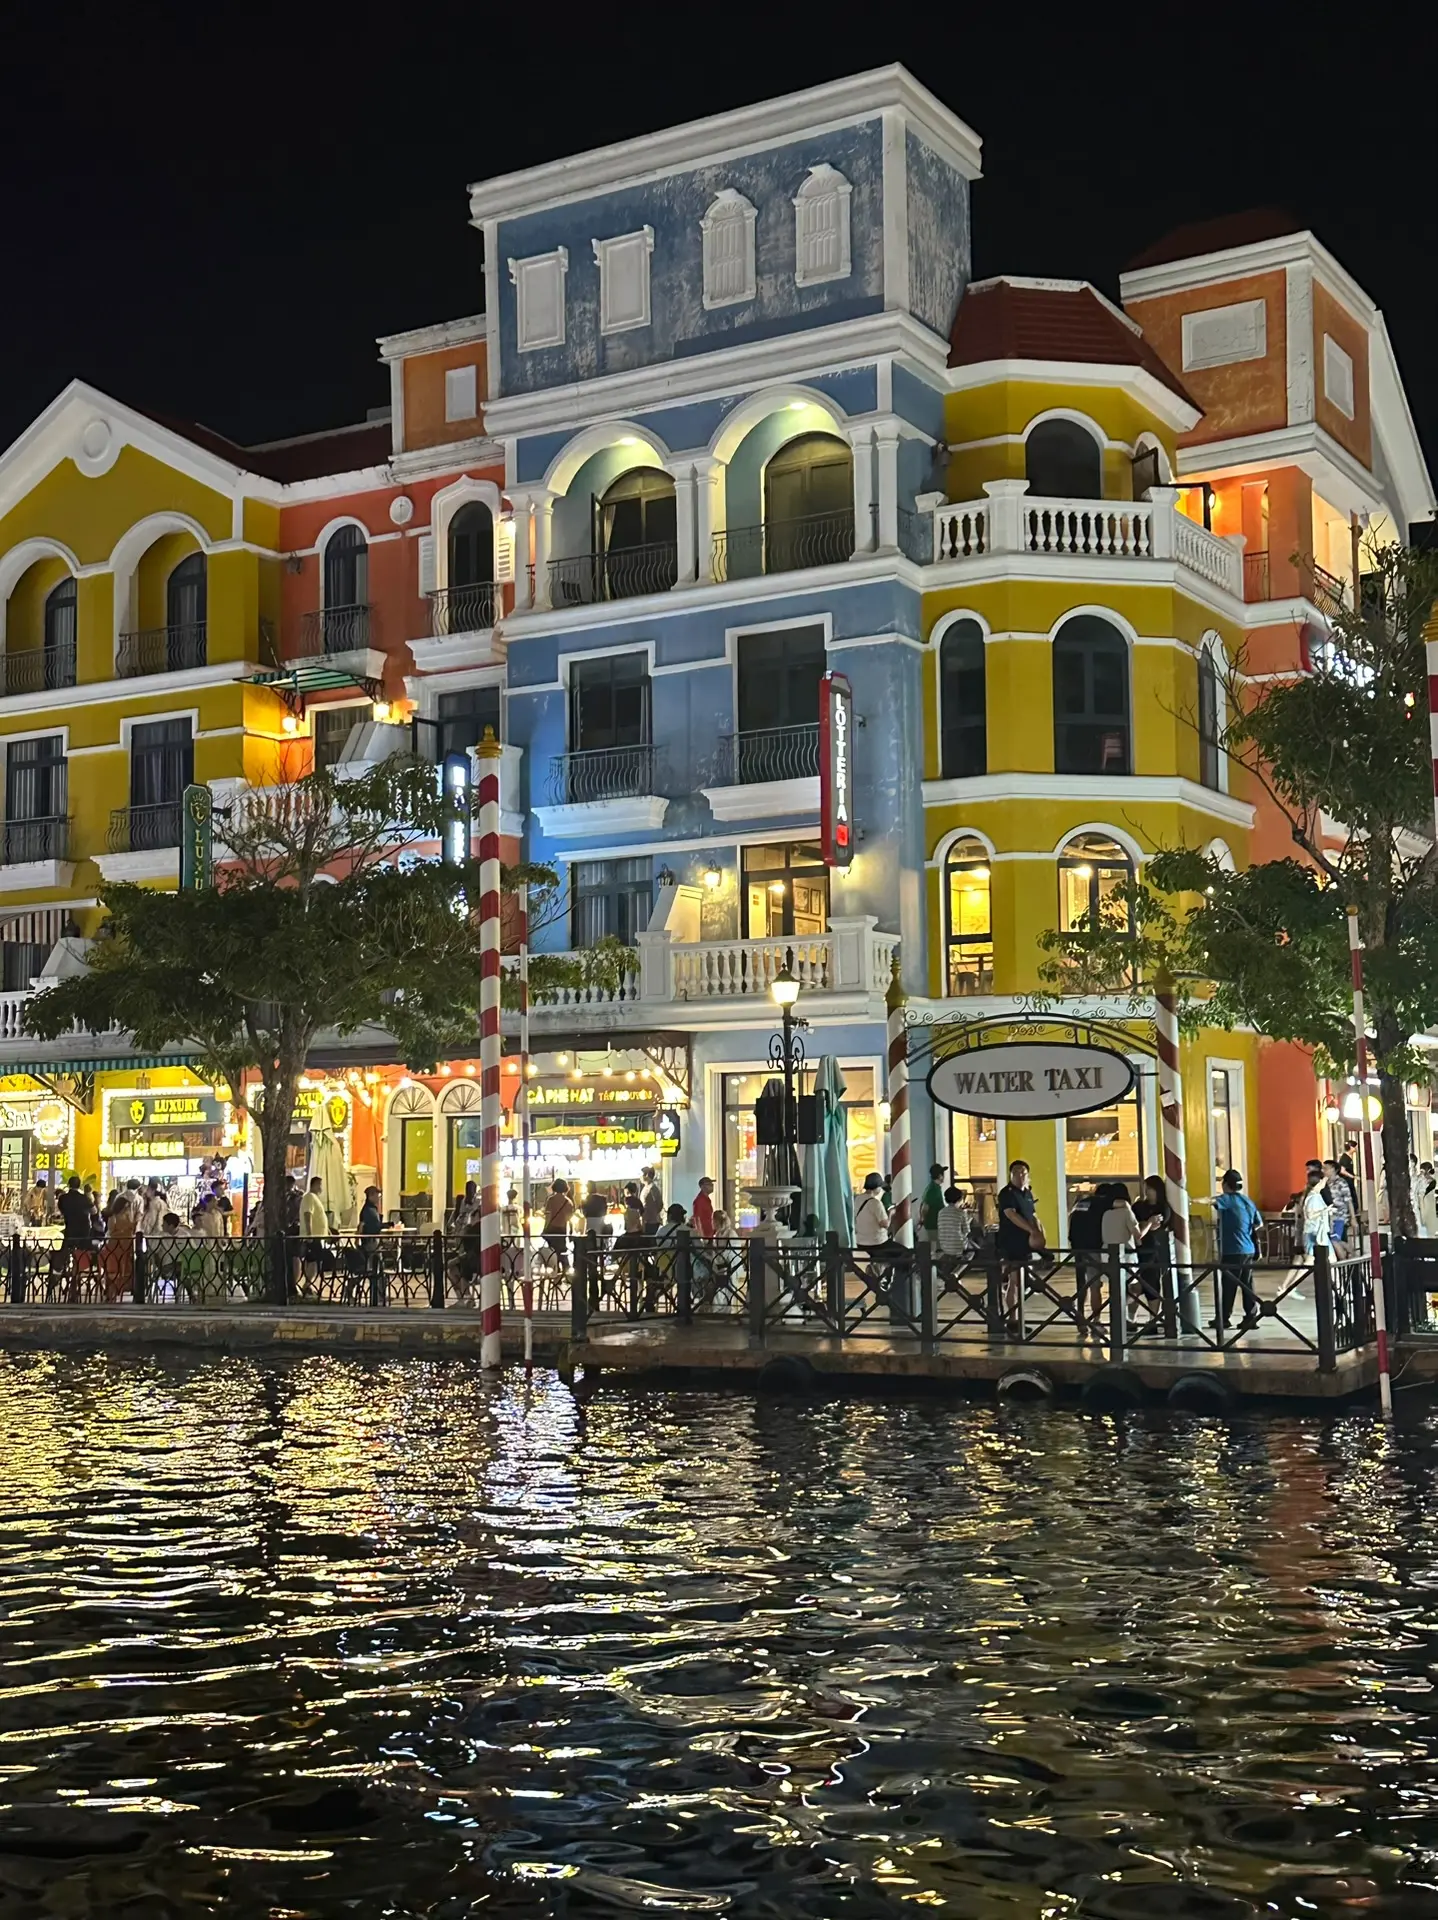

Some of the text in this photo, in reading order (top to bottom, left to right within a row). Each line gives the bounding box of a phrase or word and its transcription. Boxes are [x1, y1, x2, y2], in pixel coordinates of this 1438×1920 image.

[835, 693, 848, 822] LOTTERIA
[195, 830, 204, 890] LUXU
[953, 1067, 1104, 1095] WATER TAXI
[154, 1098, 200, 1113] LUXURY
